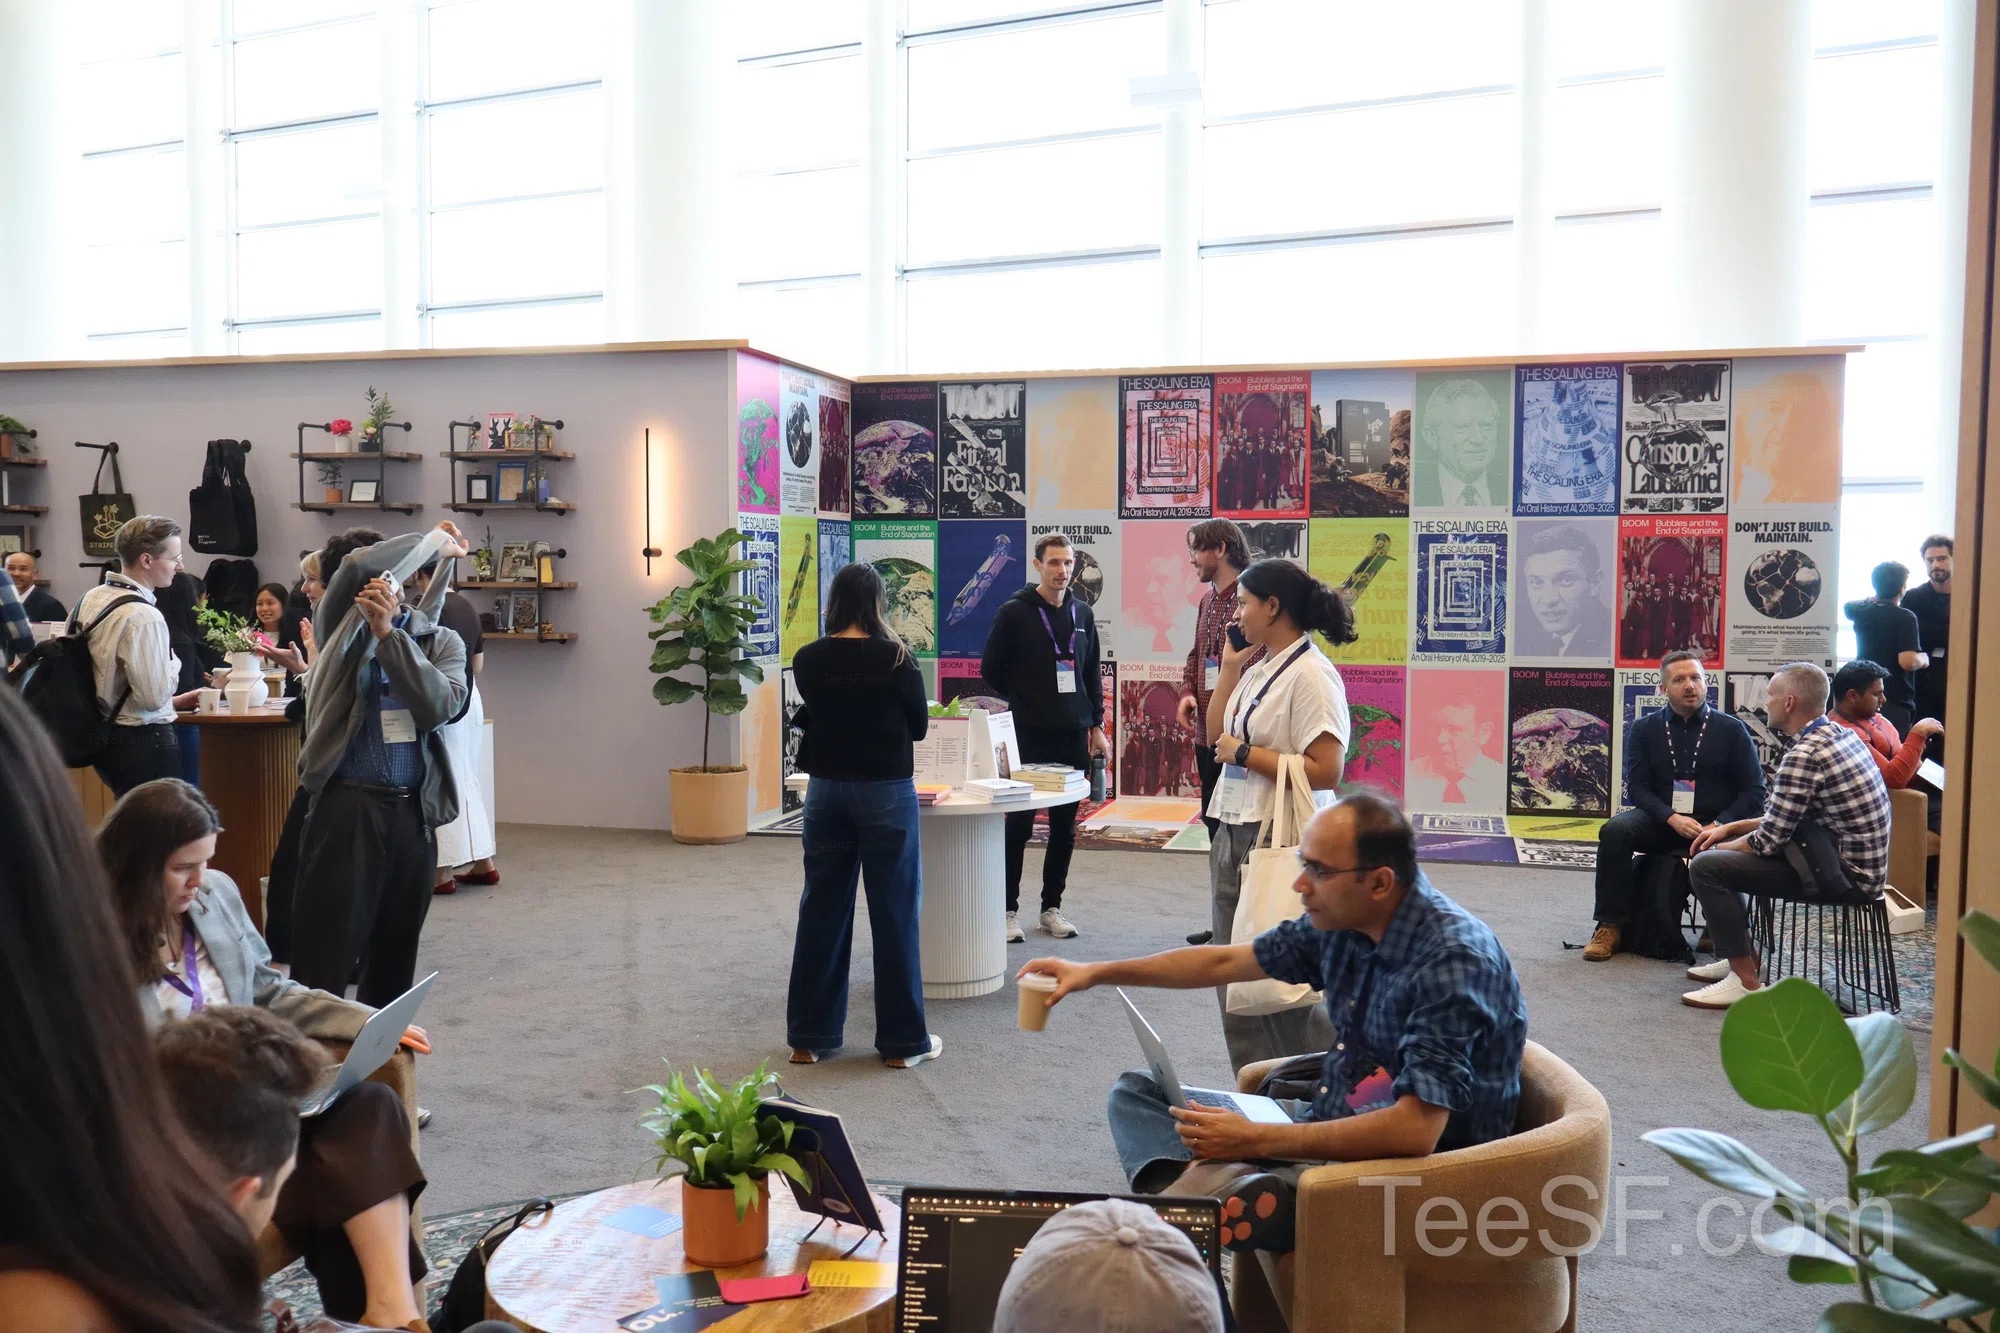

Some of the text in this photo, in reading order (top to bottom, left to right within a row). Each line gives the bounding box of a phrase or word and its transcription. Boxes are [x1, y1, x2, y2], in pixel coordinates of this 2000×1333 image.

[1519, 367, 1618, 380] THE SCALING ERA
[1122, 376, 1212, 390] THE SCALING ERA
[1270, 383, 1308, 392] Stagnation
[941, 384, 1024, 420] TACIT
[1140, 402, 1152, 410] THE
[1152, 402, 1182, 410] SCALING
[1550, 443, 1580, 451] SCALING
[1580, 440, 1592, 449] ERA
[1526, 465, 1604, 488] THE SCALING ERA
[1121, 508, 1129, 516] An
[1130, 508, 1142, 516] Oral
[1142, 508, 1162, 518] History
[1162, 508, 1169, 516] of
[1540, 504, 1562, 514] History
[750, 518, 770, 531] SCALING
[1413, 521, 1508, 532] THE SCALING ERA
[1622, 520, 1650, 528] BOOM
[1771, 522, 1797, 532] JUST
[1798, 522, 1833, 532] BUILD.
[1062, 526, 1082, 534] JUST
[1084, 526, 1112, 534] BUILD.
[1681, 527, 1724, 536] Stagnation
[1754, 532, 1813, 543] MAINTAIN.
[1446, 546, 1478, 554] SCALING
[1434, 654, 1454, 664] History
[1100, 664, 1114, 676] RA
[1364, 676, 1403, 684] Stagnation
[1618, 672, 1641, 685] THE
[1705, 673, 1720, 686] RA
[1570, 680, 1611, 688] Stagnation
[1638, 698, 1651, 706] THE
